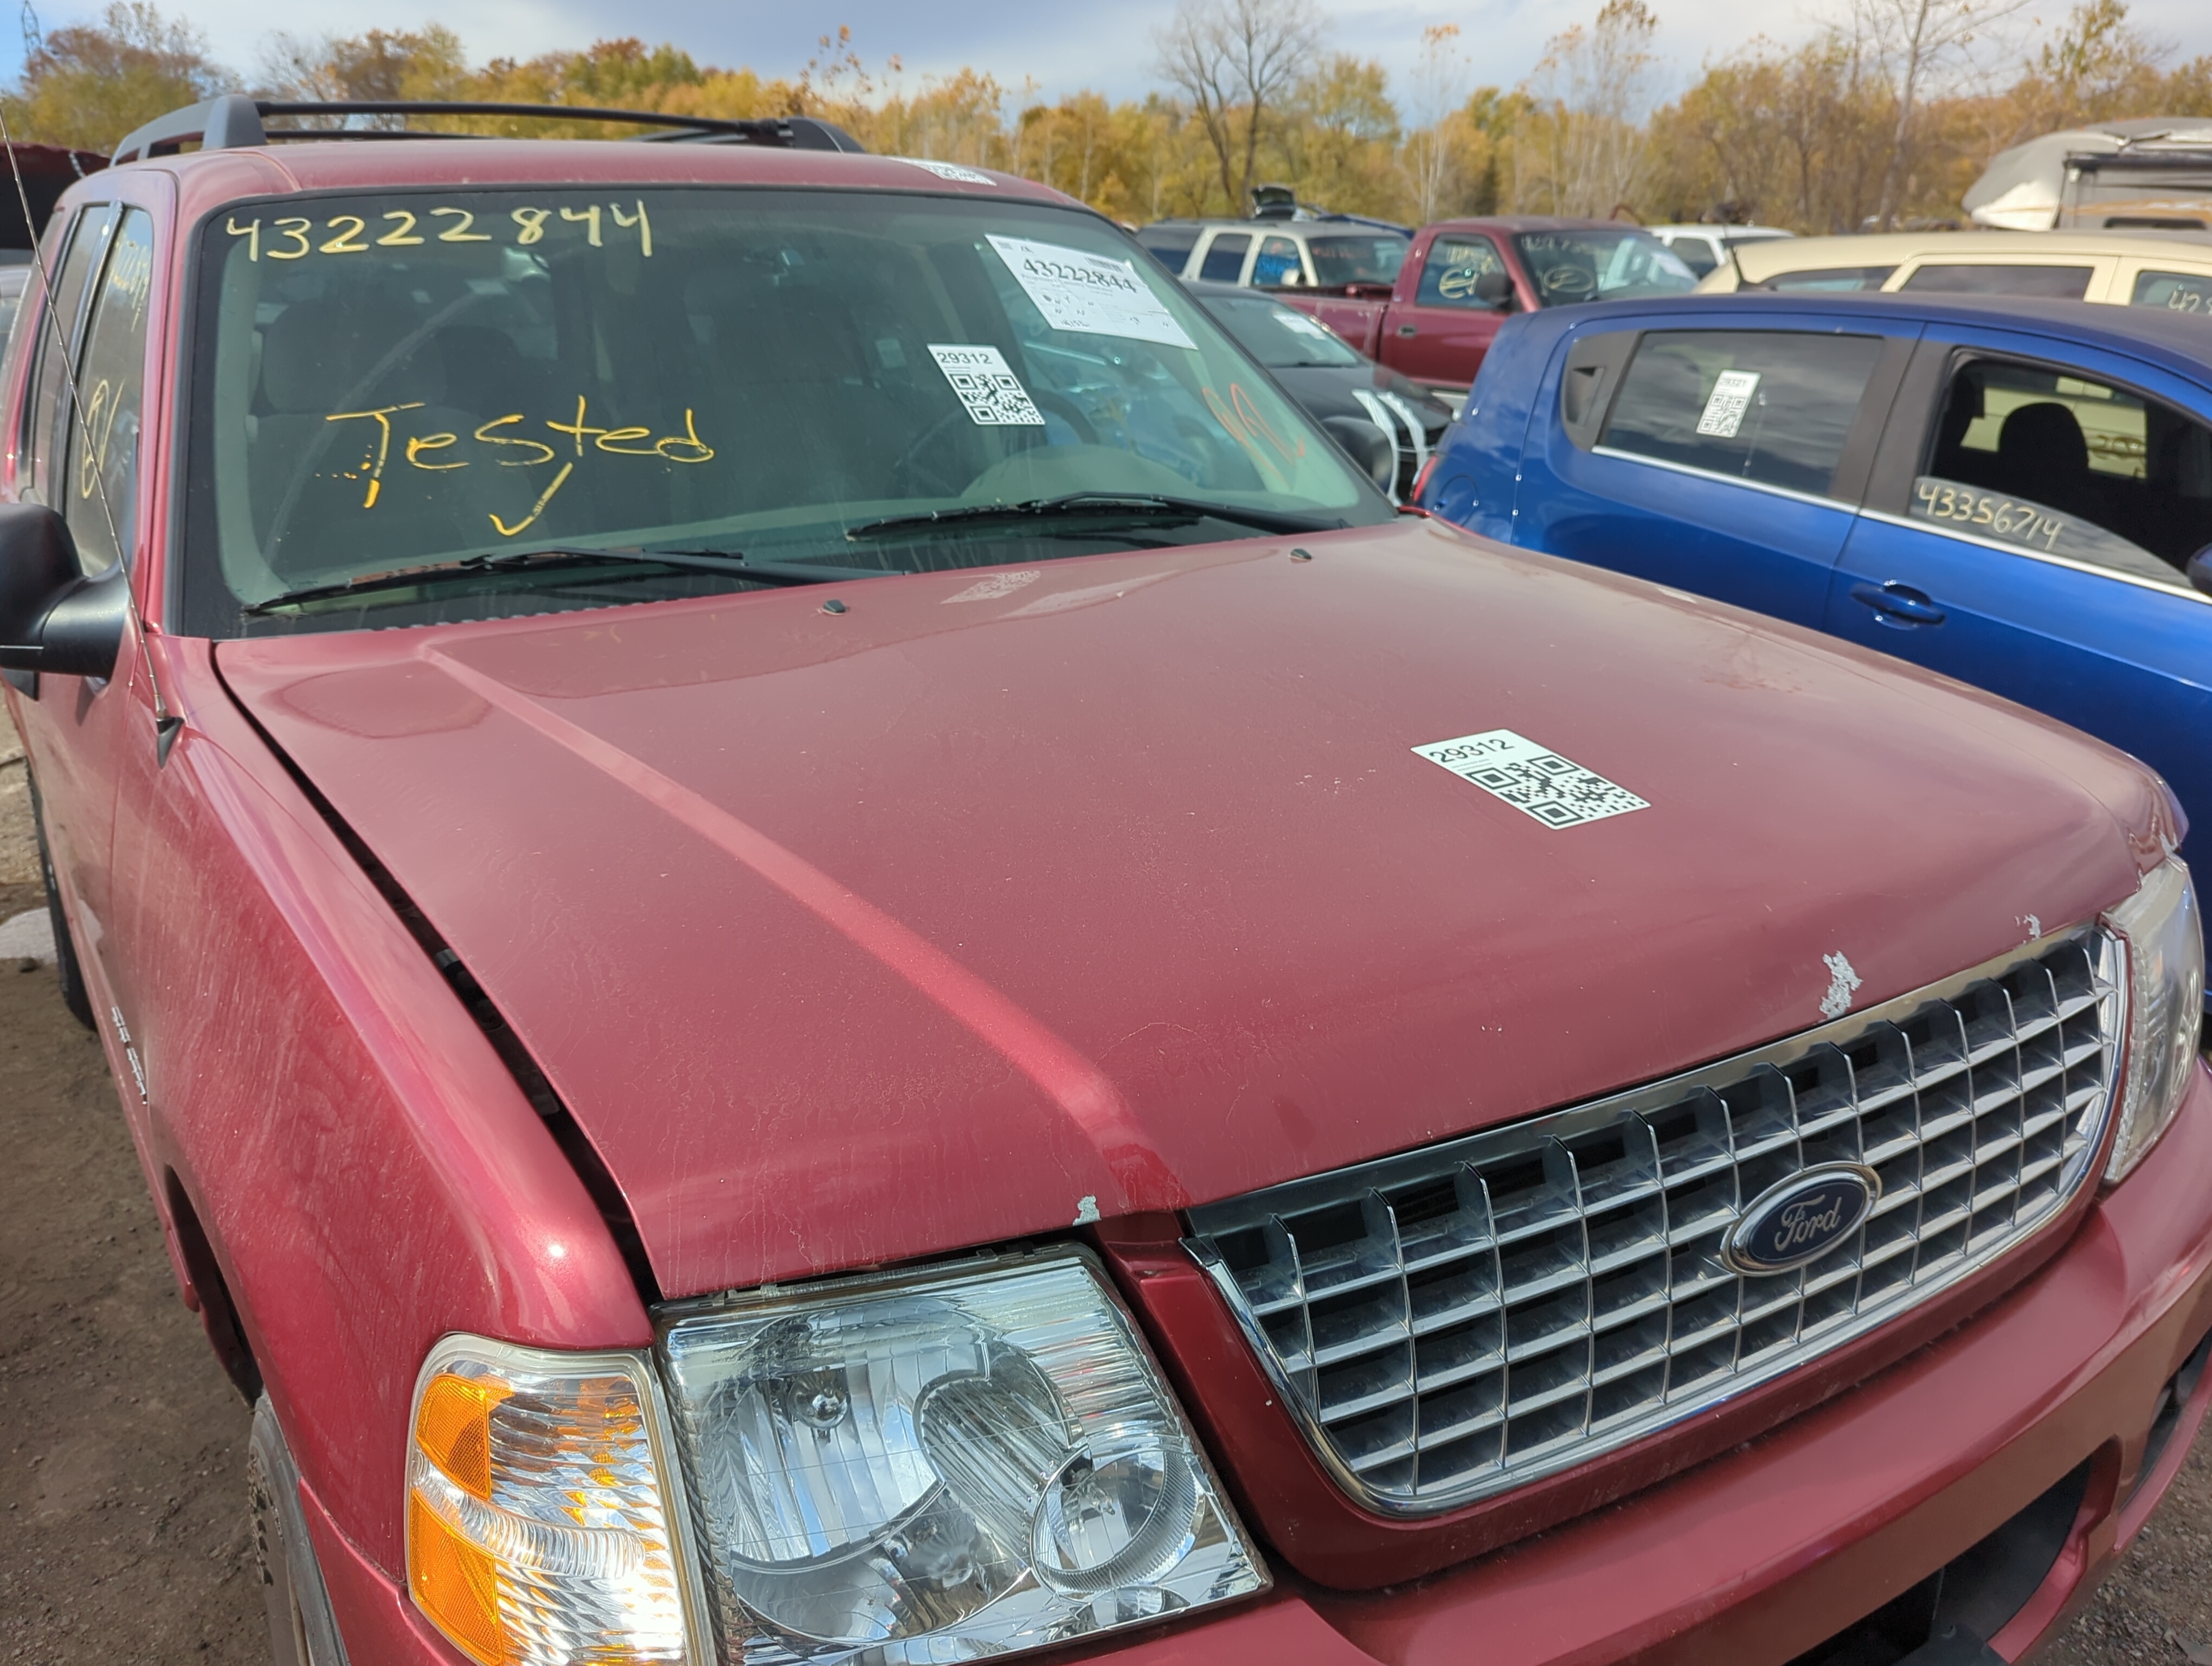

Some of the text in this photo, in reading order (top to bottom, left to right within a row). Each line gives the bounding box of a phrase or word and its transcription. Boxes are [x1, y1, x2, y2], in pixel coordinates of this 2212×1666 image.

[227, 198, 652, 261] 43222844
[1024, 258, 1137, 294] 43222844
[937, 352, 993, 364] 29312
[325, 394, 715, 508] Tested
[1918, 483, 2063, 551] 43356714
[1429, 739, 1515, 763] 29312
[1774, 1194, 1842, 1252] Ford
